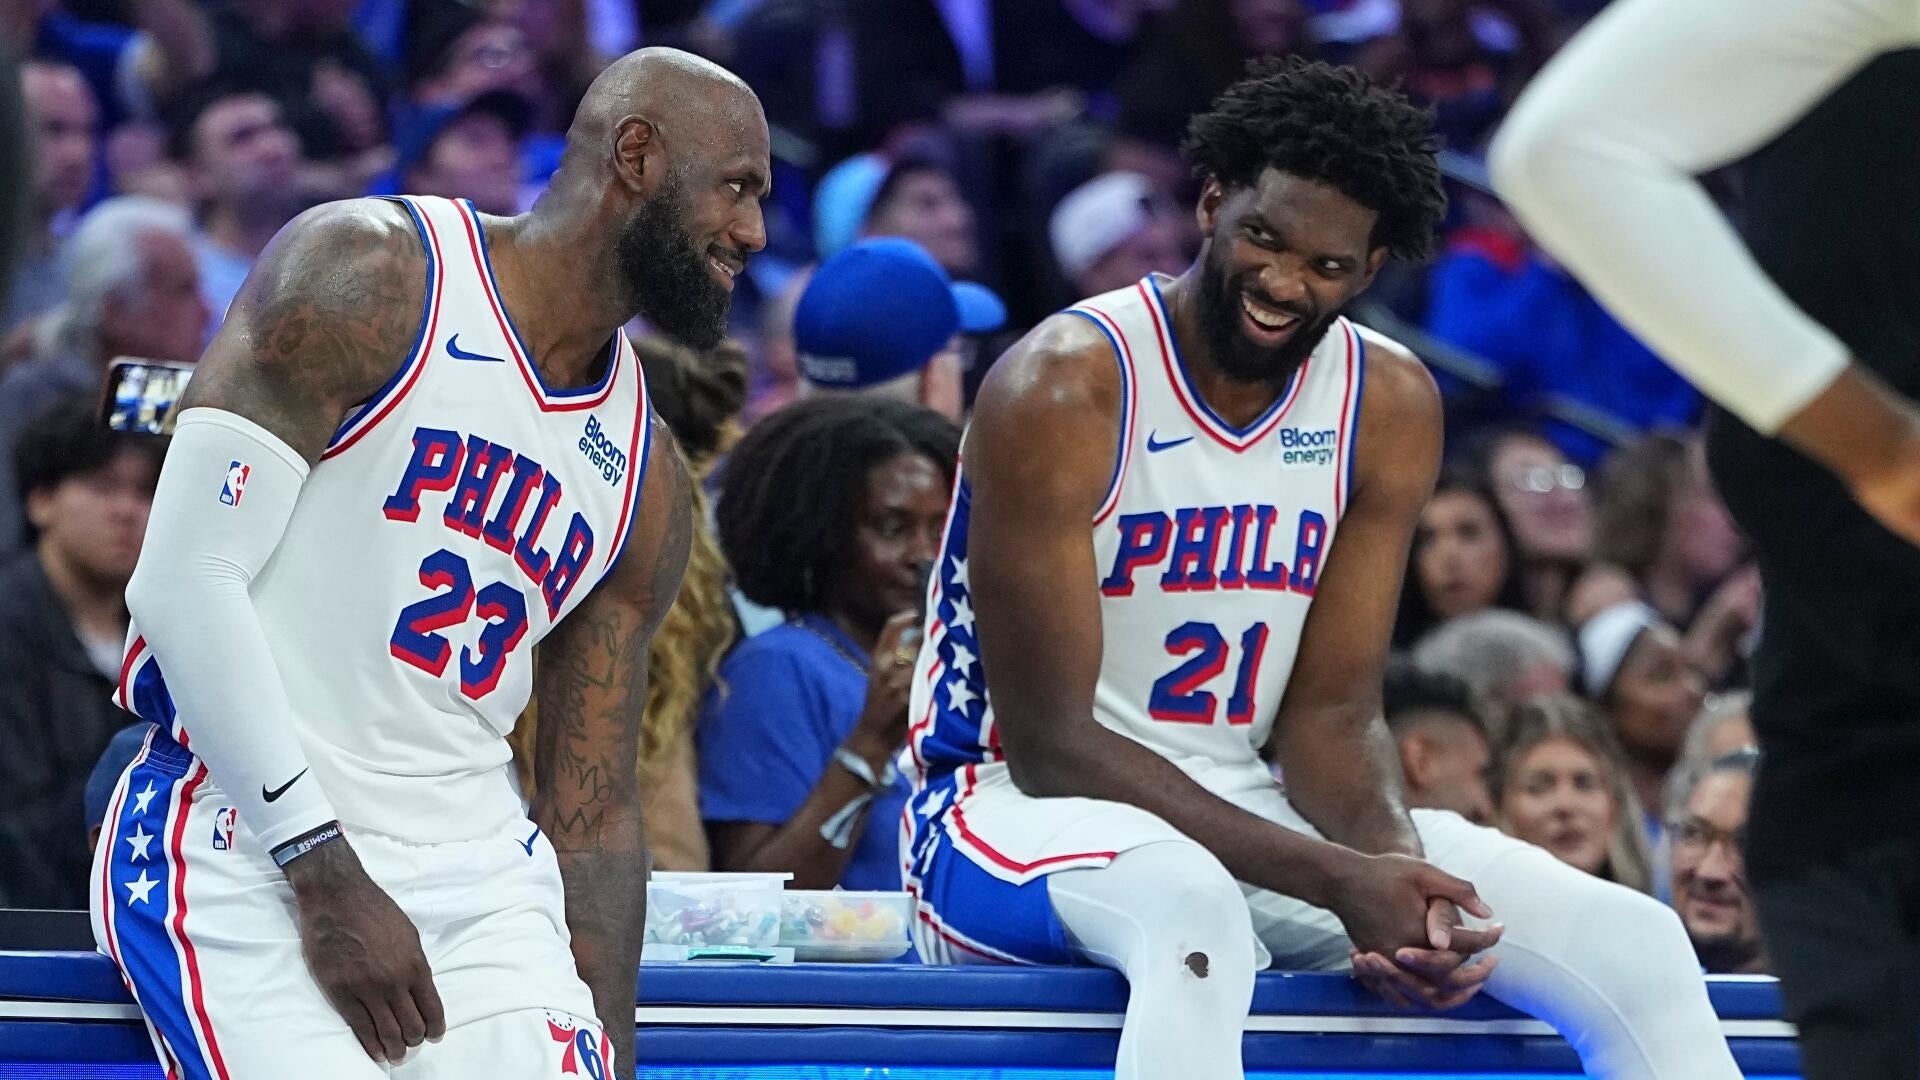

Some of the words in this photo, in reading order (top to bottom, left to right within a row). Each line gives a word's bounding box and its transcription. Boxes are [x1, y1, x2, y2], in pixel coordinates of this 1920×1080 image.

[578, 436, 622, 487] energy
[584, 413, 627, 472] Bloom
[1280, 427, 1336, 447] Bloom
[1283, 449, 1336, 466] energy
[382, 426, 594, 624] PHILA
[1100, 504, 1328, 599] PHILA
[390, 548, 529, 701] 23
[1147, 621, 1270, 726] 21
[546, 1018, 607, 1080] 76
